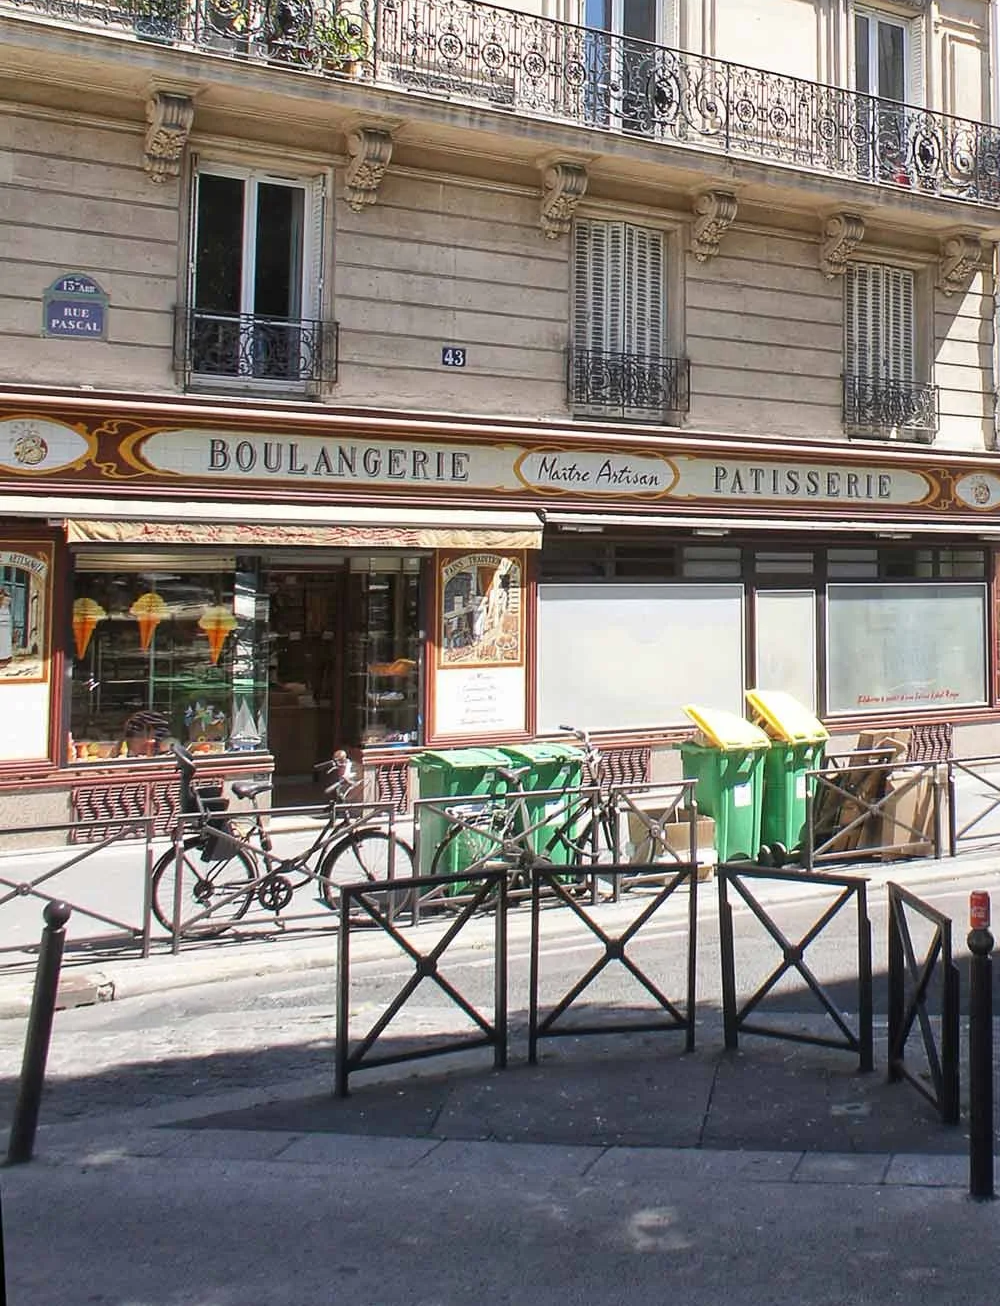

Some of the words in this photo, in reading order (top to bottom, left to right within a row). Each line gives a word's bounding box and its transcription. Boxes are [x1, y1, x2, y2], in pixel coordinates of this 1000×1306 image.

[64, 308, 89, 318] RUE
[51, 319, 100, 331] PASCAL
[444, 349, 464, 366] 43
[207, 437, 471, 482] BOULANGERIE
[537, 456, 590, 482] Maître
[595, 459, 661, 486] Artisan
[712, 466, 893, 499] PATISSERIE
